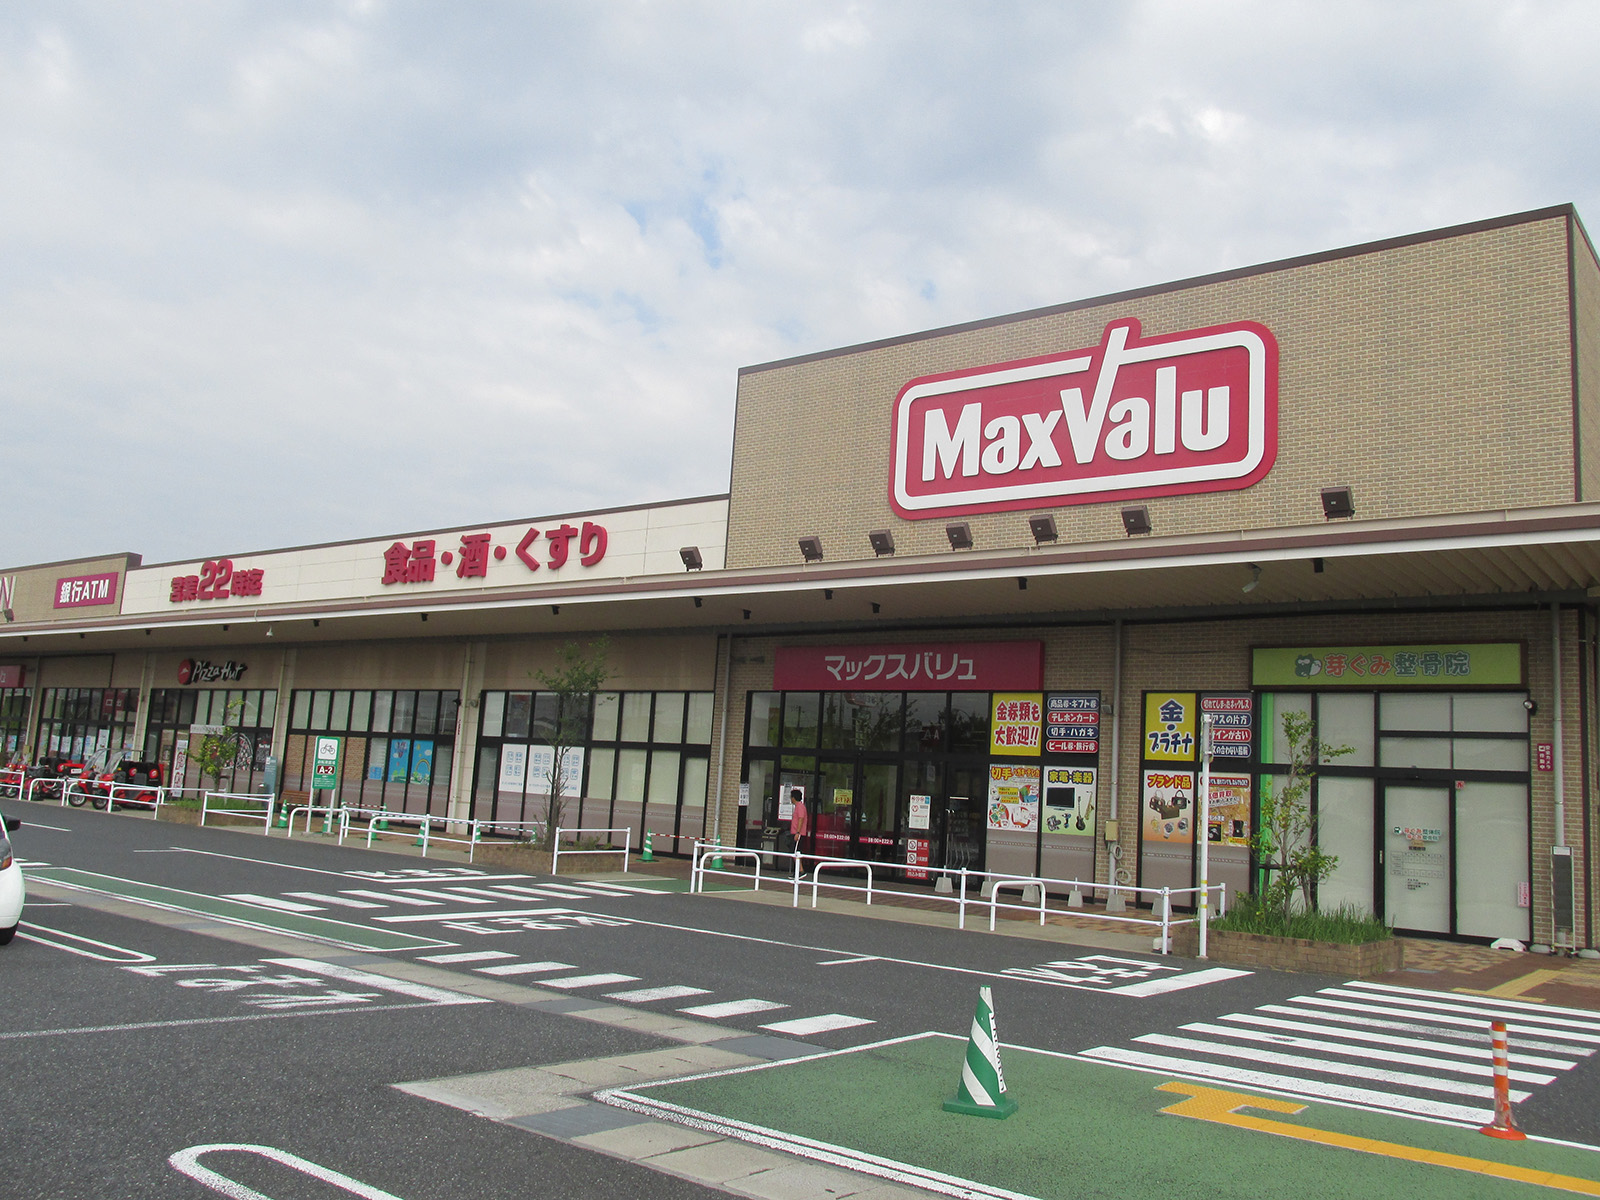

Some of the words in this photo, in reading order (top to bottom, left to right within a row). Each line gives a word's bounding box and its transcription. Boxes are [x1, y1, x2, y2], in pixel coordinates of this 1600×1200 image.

[922, 326, 1230, 482] MaxValu
[381, 521, 608, 585] 食品・酒・くすり
[59, 579, 110, 603] 銀行ATM
[191, 661, 220, 681] Pizza
[220, 661, 244, 679] Hut
[824, 652, 977, 681] マックスバリュ
[1324, 651, 1471, 677] 芽ぐみ整骨院
[996, 701, 1041, 721] 金券類も
[1051, 713, 1096, 721] テレホンカード
[1159, 699, 1184, 722] 金
[1211, 714, 1248, 725] アスの片方
[1050, 727, 1095, 737] 切手・ハガキ
[1148, 731, 1193, 753] プラチナ
[318, 765, 333, 775] A-2
[1048, 769, 1094, 784] 家電・楽器
[1148, 774, 1191, 789] ブランド品
[438, 914, 634, 935] 止まれ
[999, 954, 1183, 985] 止まれ
[119, 963, 384, 1009] 止まれ
